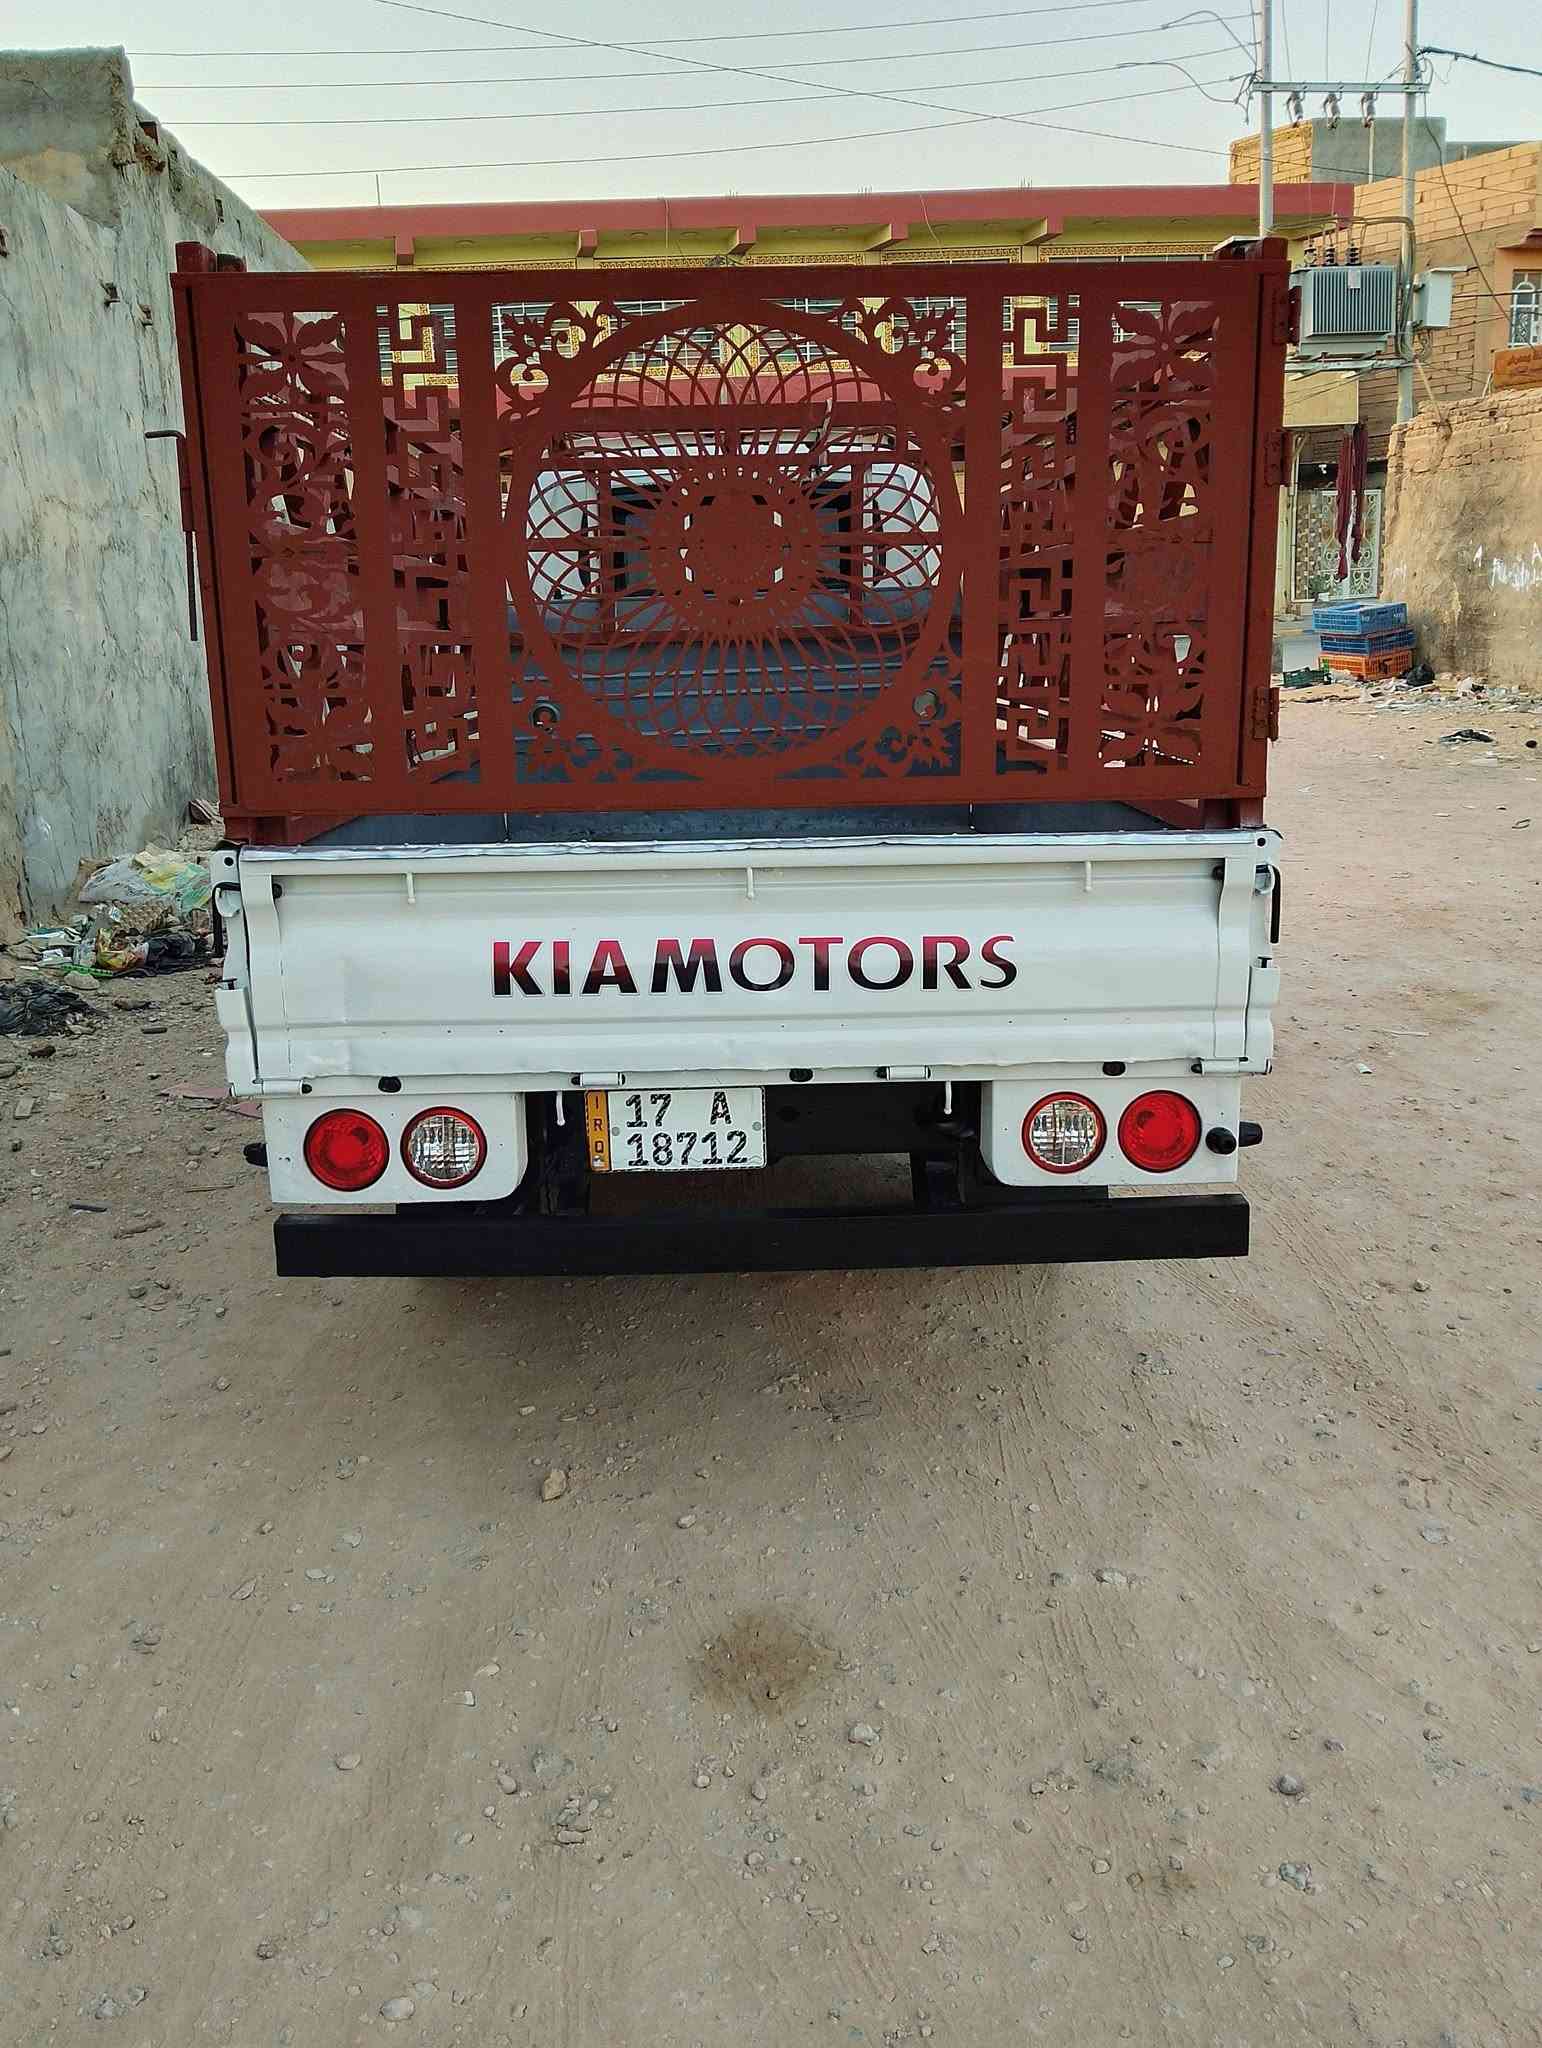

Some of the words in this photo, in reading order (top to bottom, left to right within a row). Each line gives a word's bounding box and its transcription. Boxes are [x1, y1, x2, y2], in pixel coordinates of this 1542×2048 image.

[625, 1094, 672, 1127] 17
[710, 1091, 732, 1125] A
[627, 1130, 748, 1167] 18712
